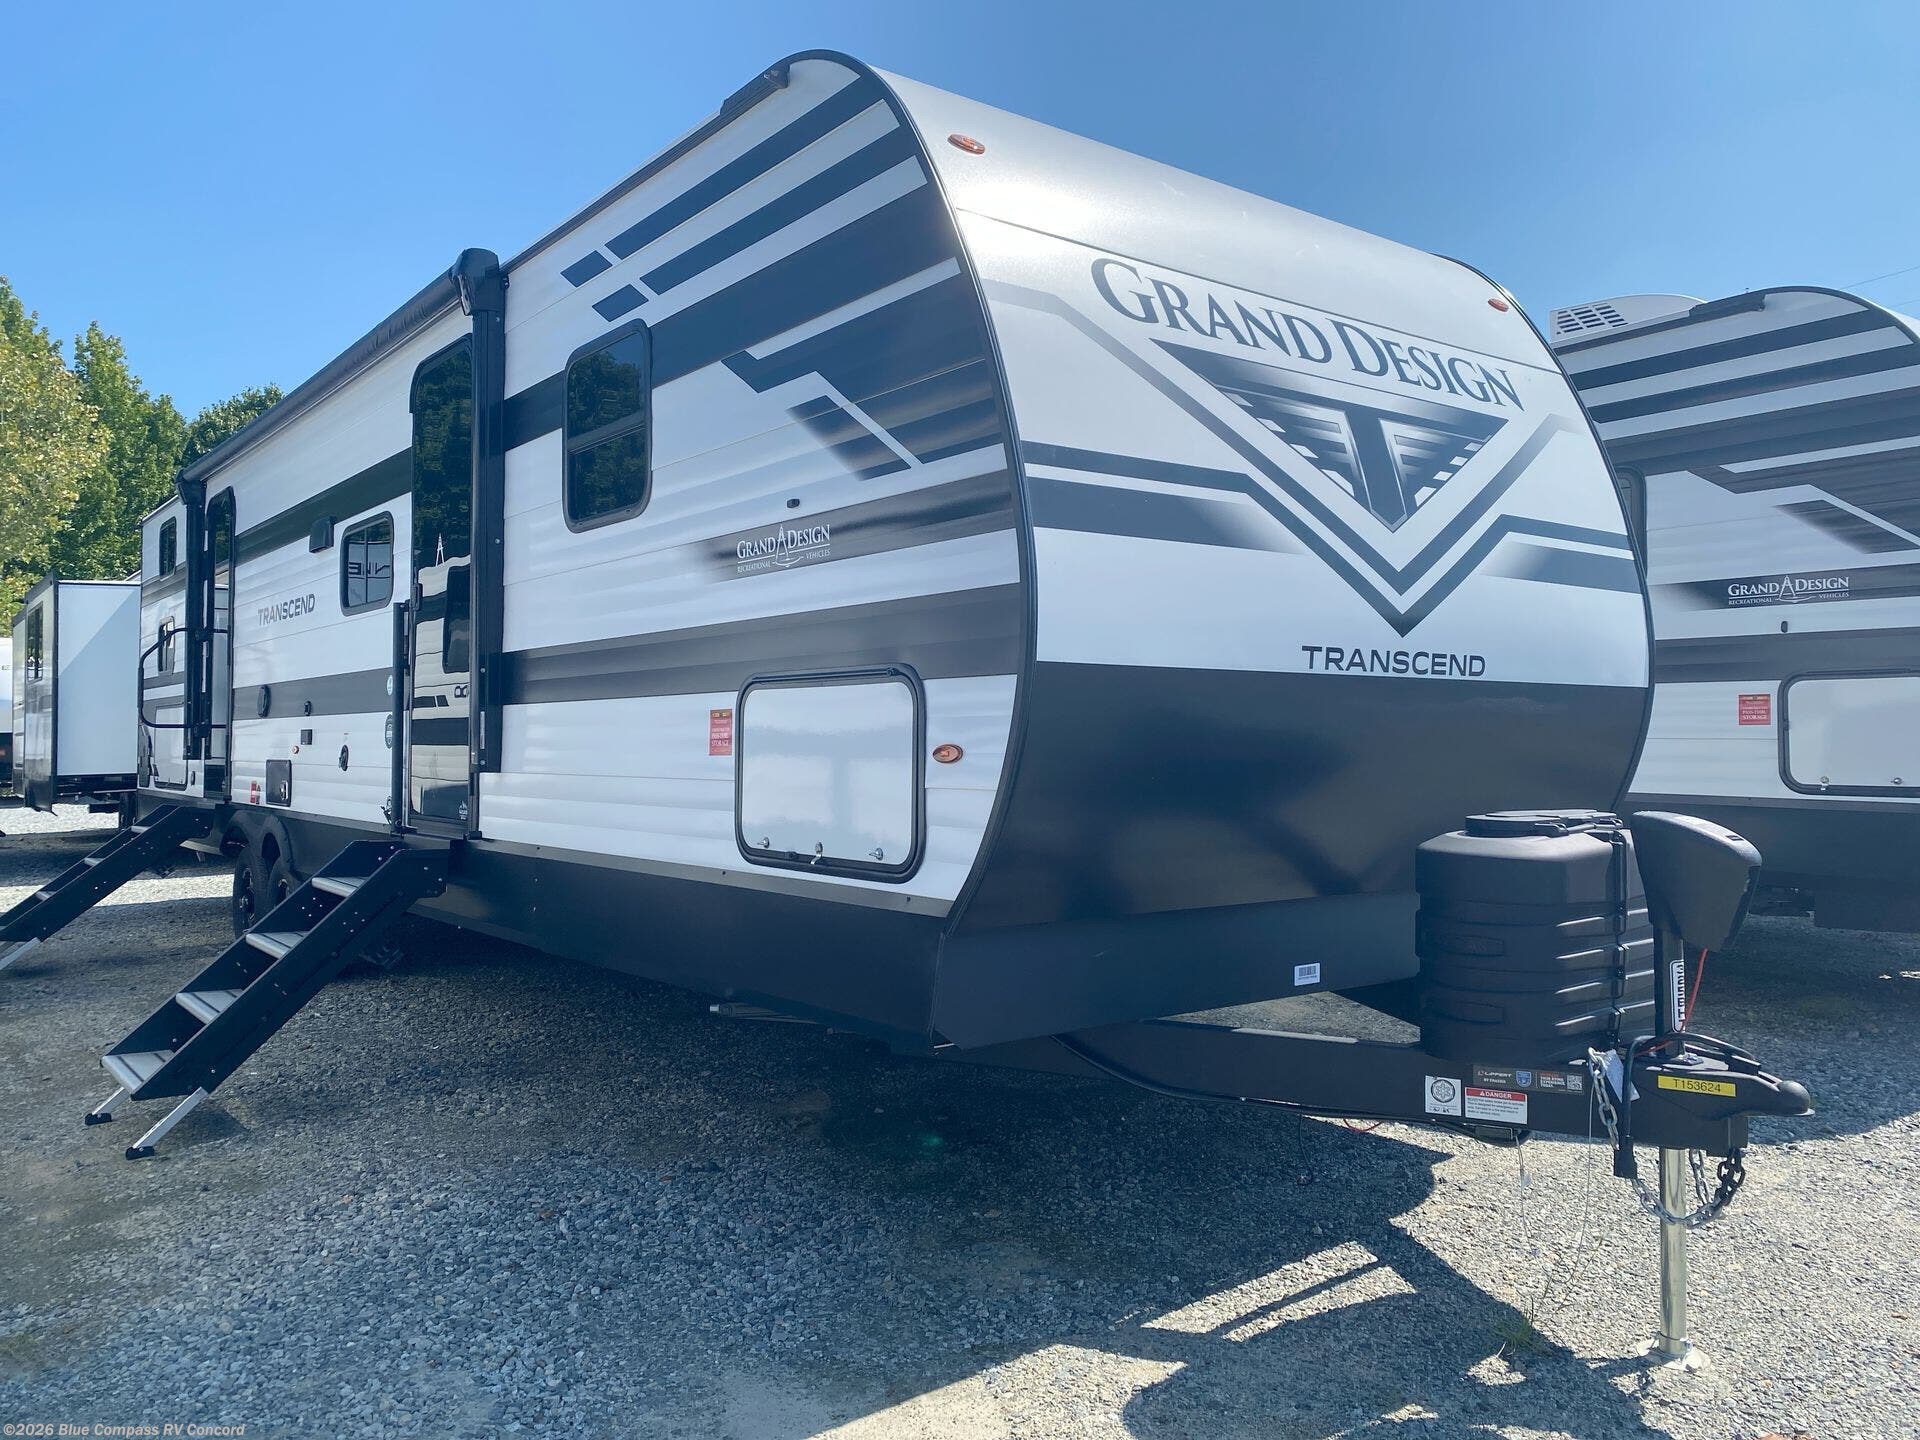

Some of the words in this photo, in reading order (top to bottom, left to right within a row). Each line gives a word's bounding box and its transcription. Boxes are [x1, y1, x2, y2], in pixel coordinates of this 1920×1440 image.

[1091, 257, 1333, 365] GRAND
[1325, 316, 1526, 412] DESIGN
[736, 536, 777, 560] GRAND
[787, 524, 830, 548] DESIGN
[736, 560, 771, 573] RECREATIONAL
[805, 548, 831, 560] VEHICLES
[1727, 582, 1780, 596] GRAND
[1795, 576, 1850, 591] DESIGN
[1728, 597, 1773, 605] RECREATIONAL
[1818, 591, 1850, 599] VEHICLES
[257, 593, 315, 626] TRANSCEND
[1302, 645, 1486, 678] TRANSCEND
[1485, 1091, 1512, 1099] DANGER
[1673, 1079, 1721, 1092] T153624
